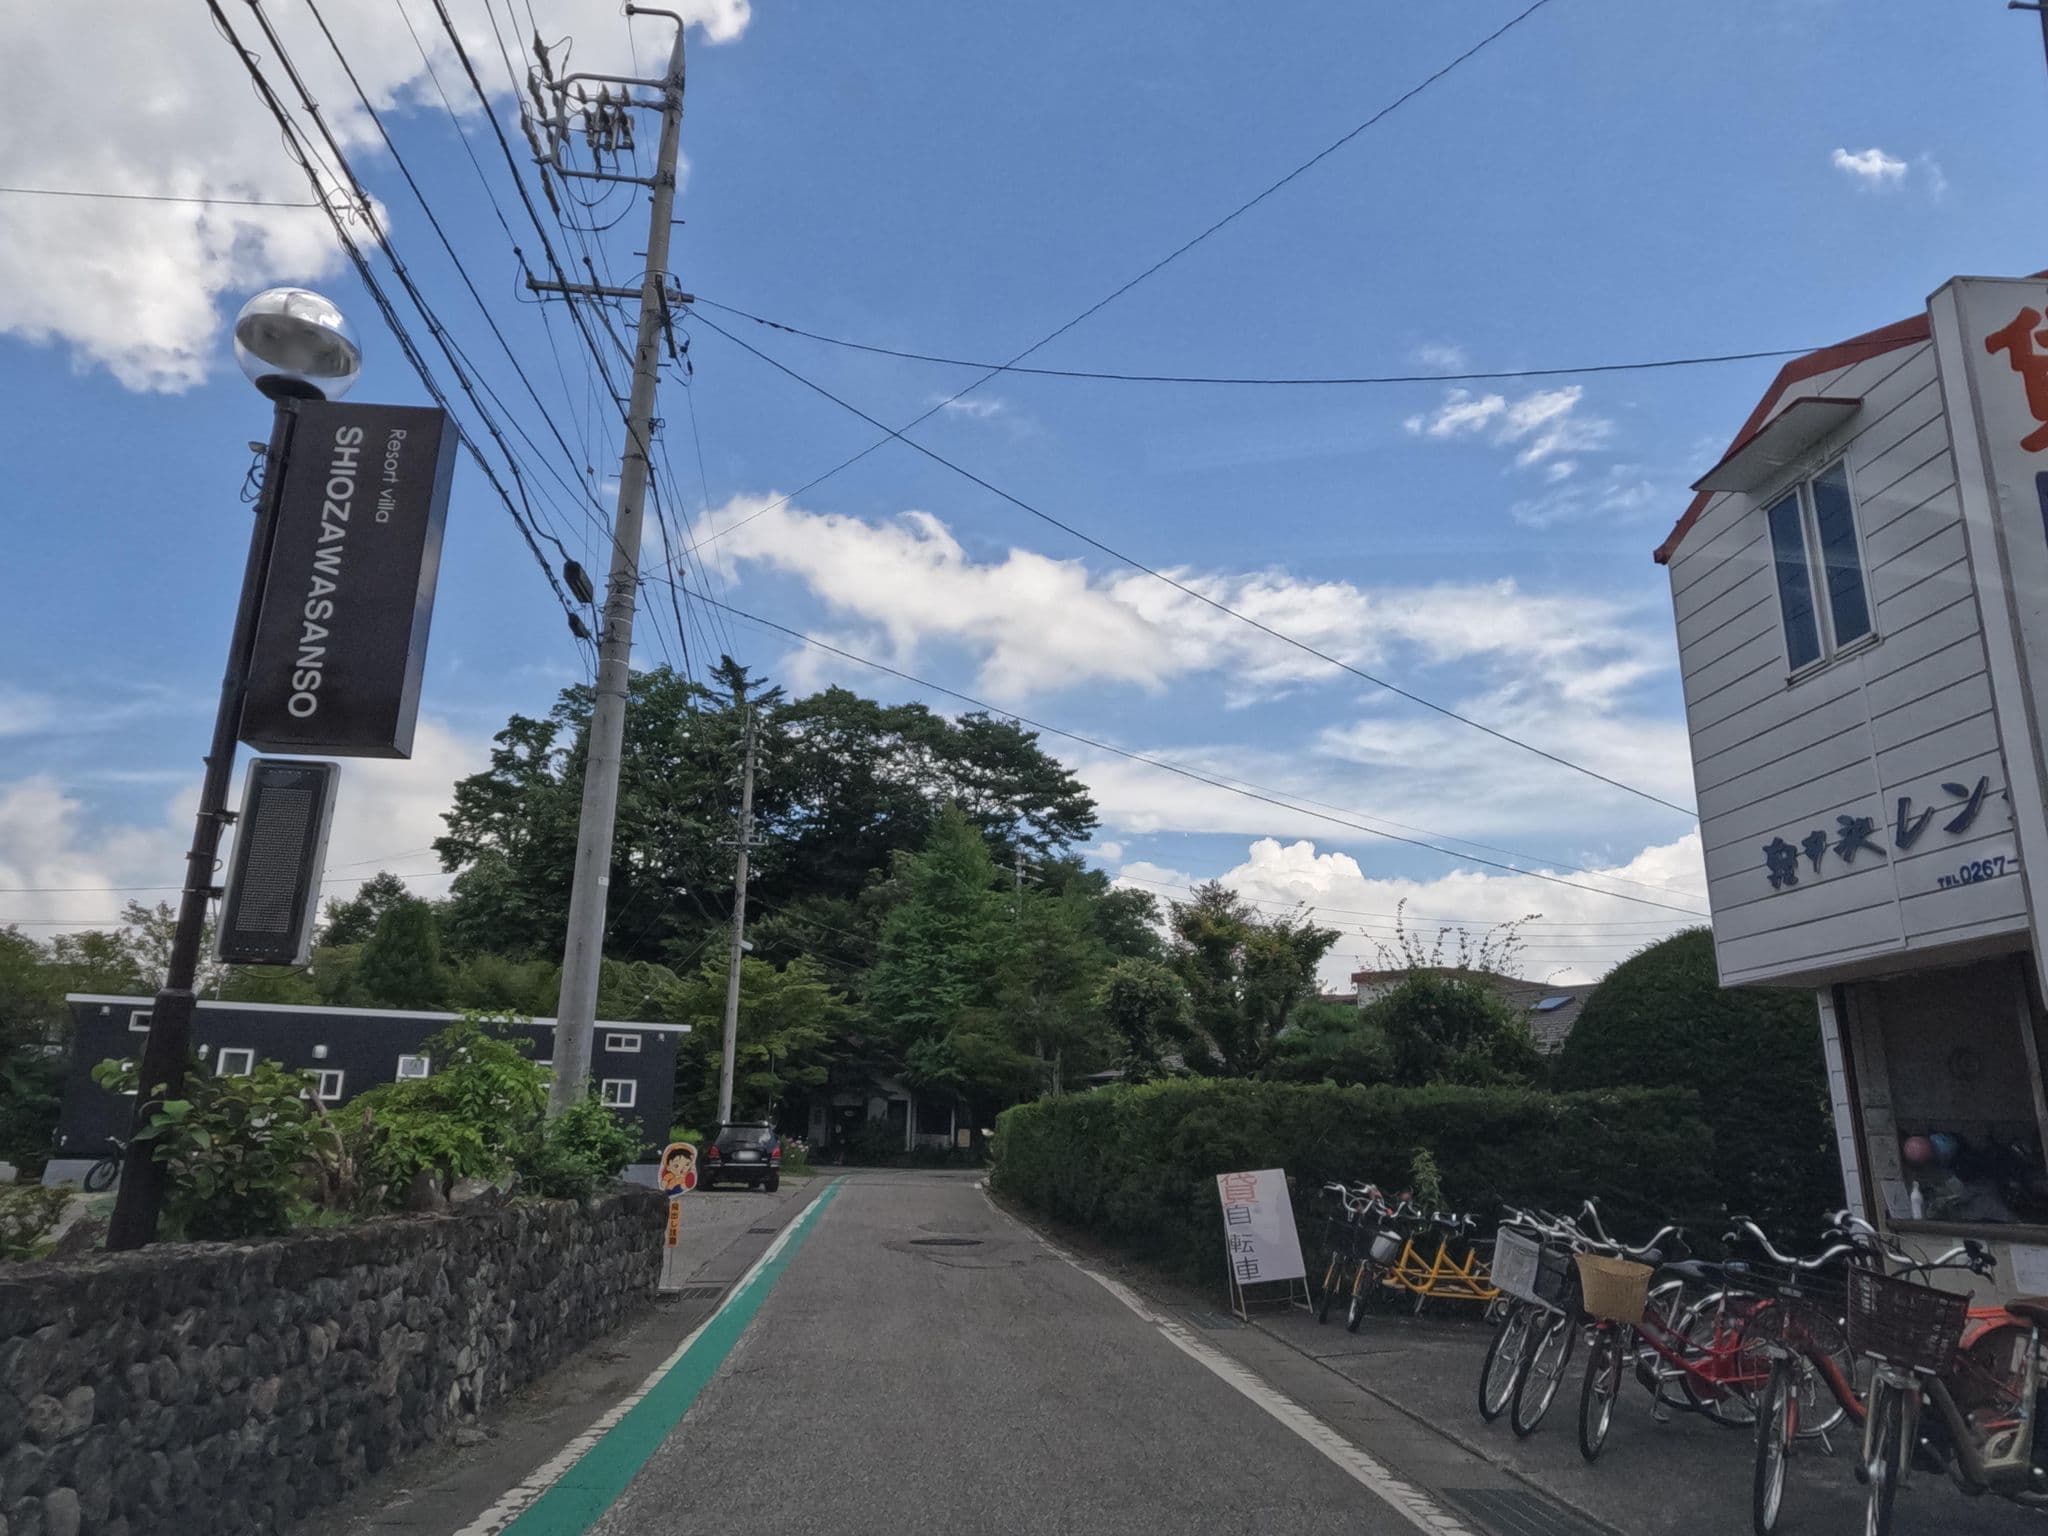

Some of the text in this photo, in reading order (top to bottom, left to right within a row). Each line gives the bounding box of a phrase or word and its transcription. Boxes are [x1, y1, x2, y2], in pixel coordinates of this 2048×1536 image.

[288, 425, 364, 718] SHIOZAWASANSO
[375, 428, 407, 523] Resort villa
